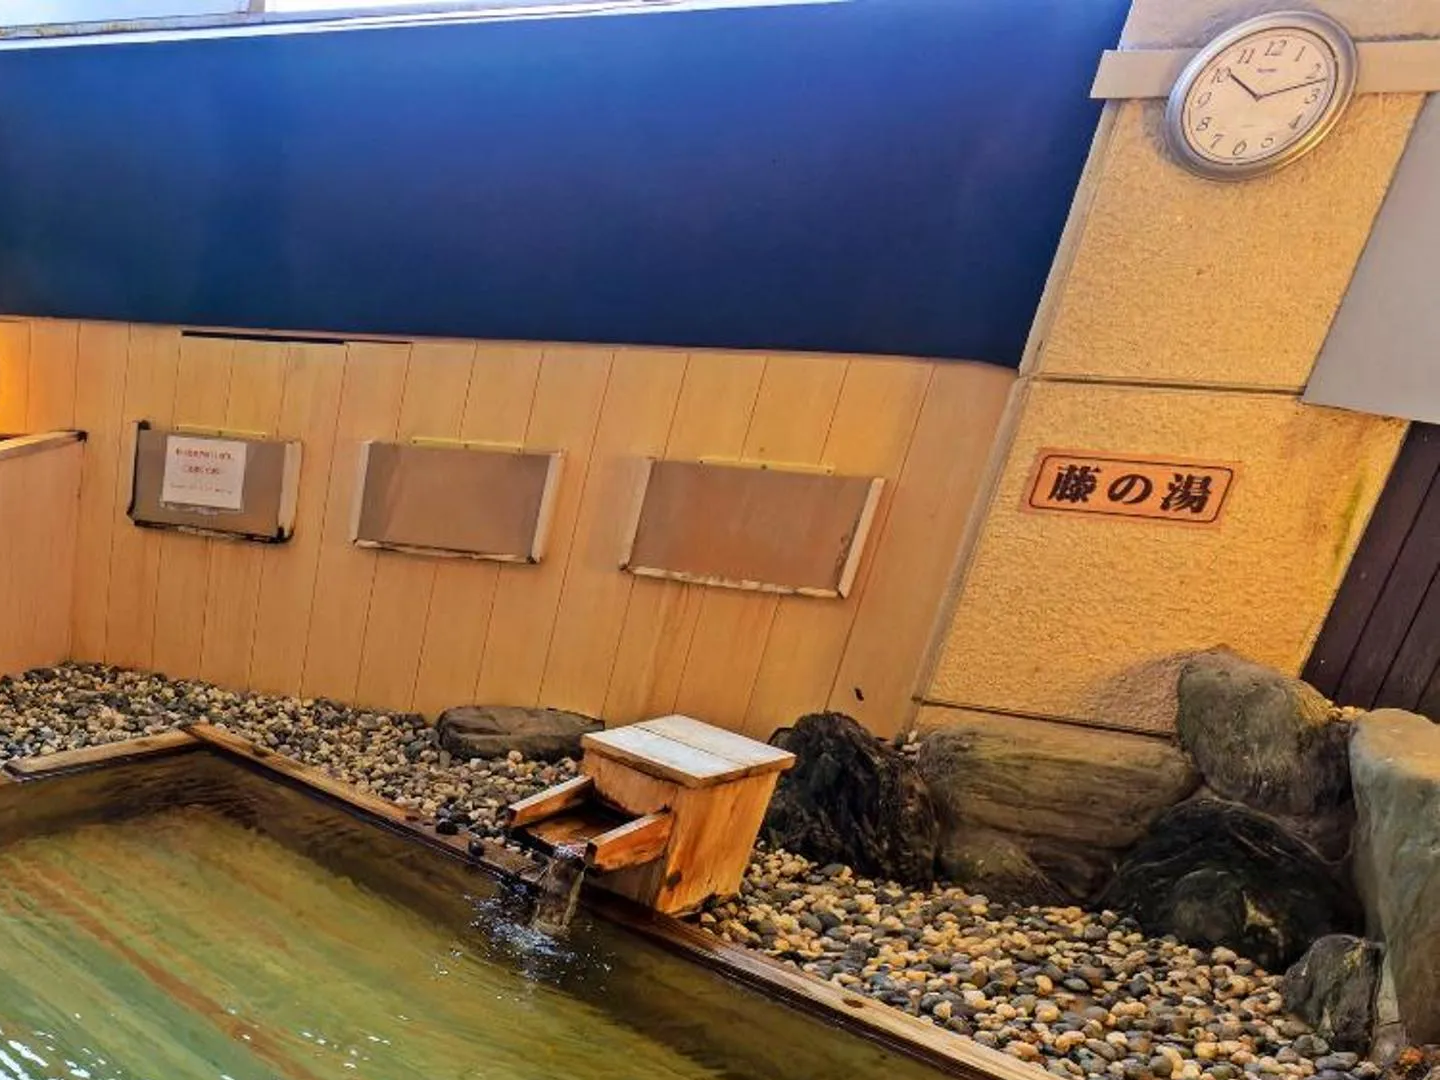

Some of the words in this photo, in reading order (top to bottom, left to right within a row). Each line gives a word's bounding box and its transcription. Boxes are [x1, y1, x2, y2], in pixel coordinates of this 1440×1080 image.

[1237, 48, 1256, 65] 11
[1264, 39, 1287, 57] 12
[1295, 46, 1306, 62] 1
[1211, 66, 1232, 84] 10
[1305, 63, 1322, 80] 2
[1304, 88, 1321, 105] 3
[1196, 116, 1212, 132] 8
[1210, 133, 1224, 150] 7
[1048, 464, 1212, 513] 藤の湯
